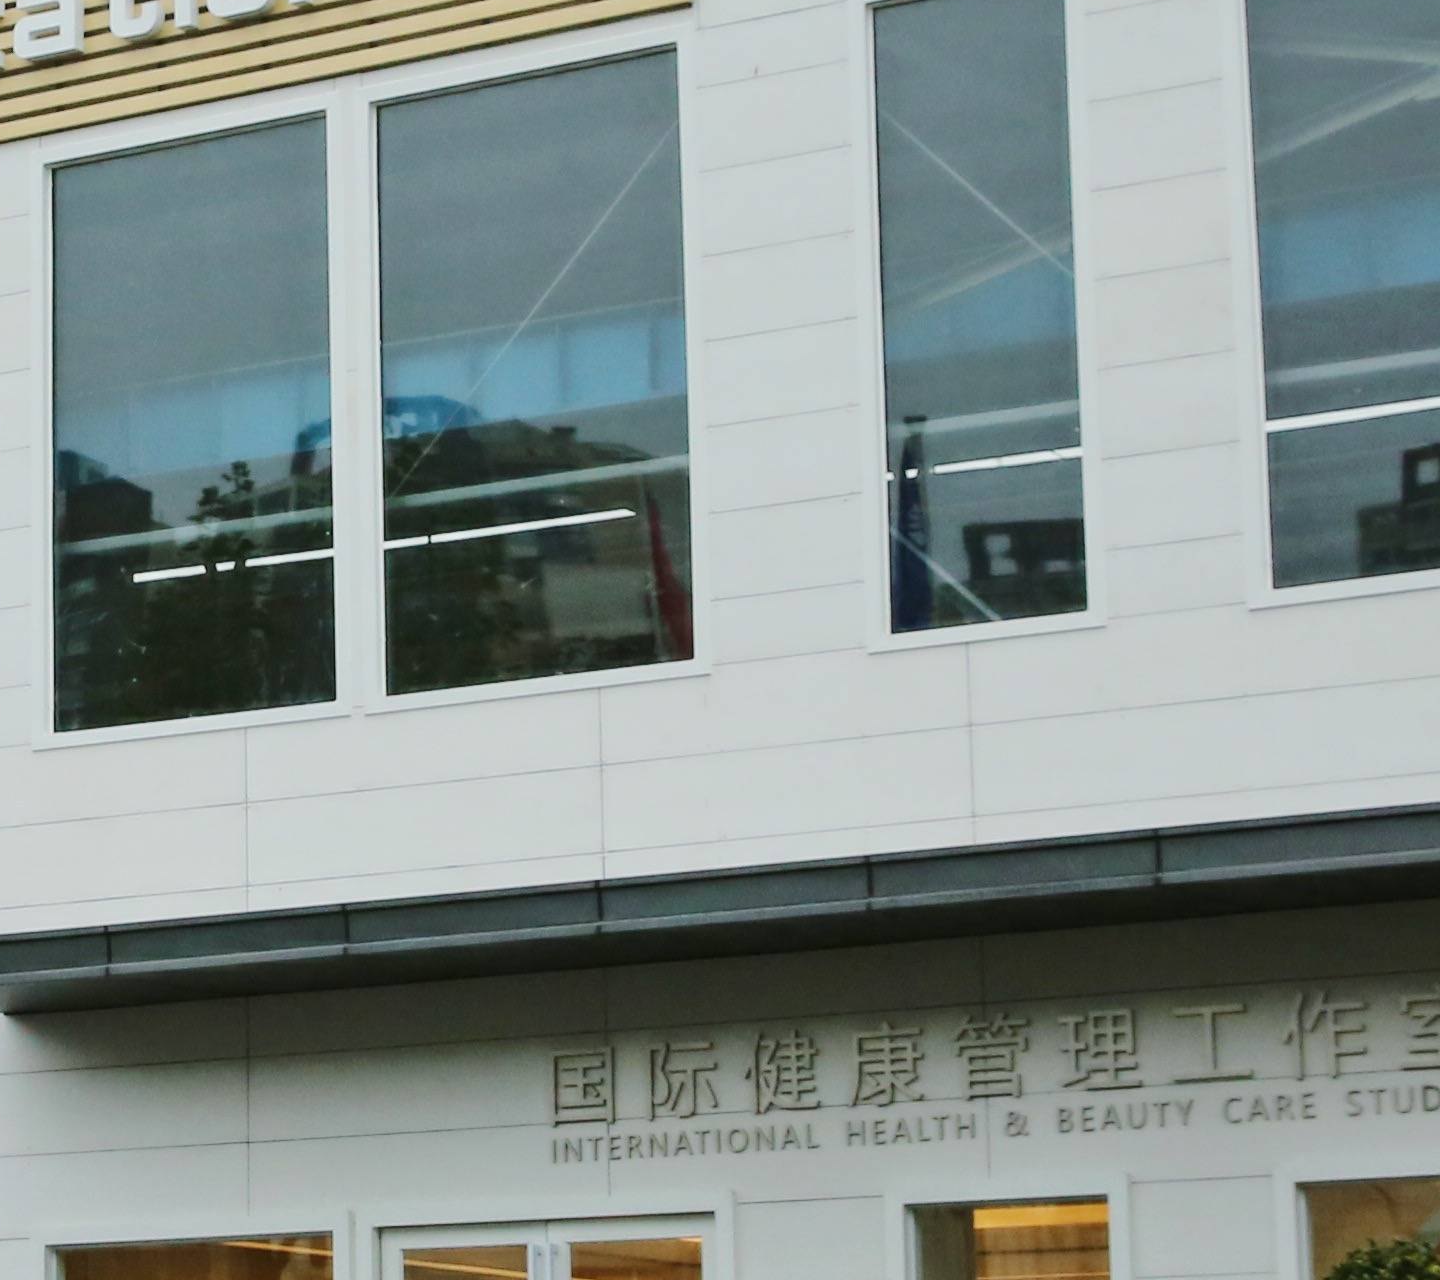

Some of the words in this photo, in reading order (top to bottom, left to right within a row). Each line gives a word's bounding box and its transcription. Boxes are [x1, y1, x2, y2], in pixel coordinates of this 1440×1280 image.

[551, 1121, 822, 1164] INTERNATIONAL
[846, 1112, 978, 1147] HEALTH
[1004, 1110, 1031, 1138] &
[1057, 1098, 1195, 1134] BEAUTY
[1223, 1091, 1317, 1124] CARE
